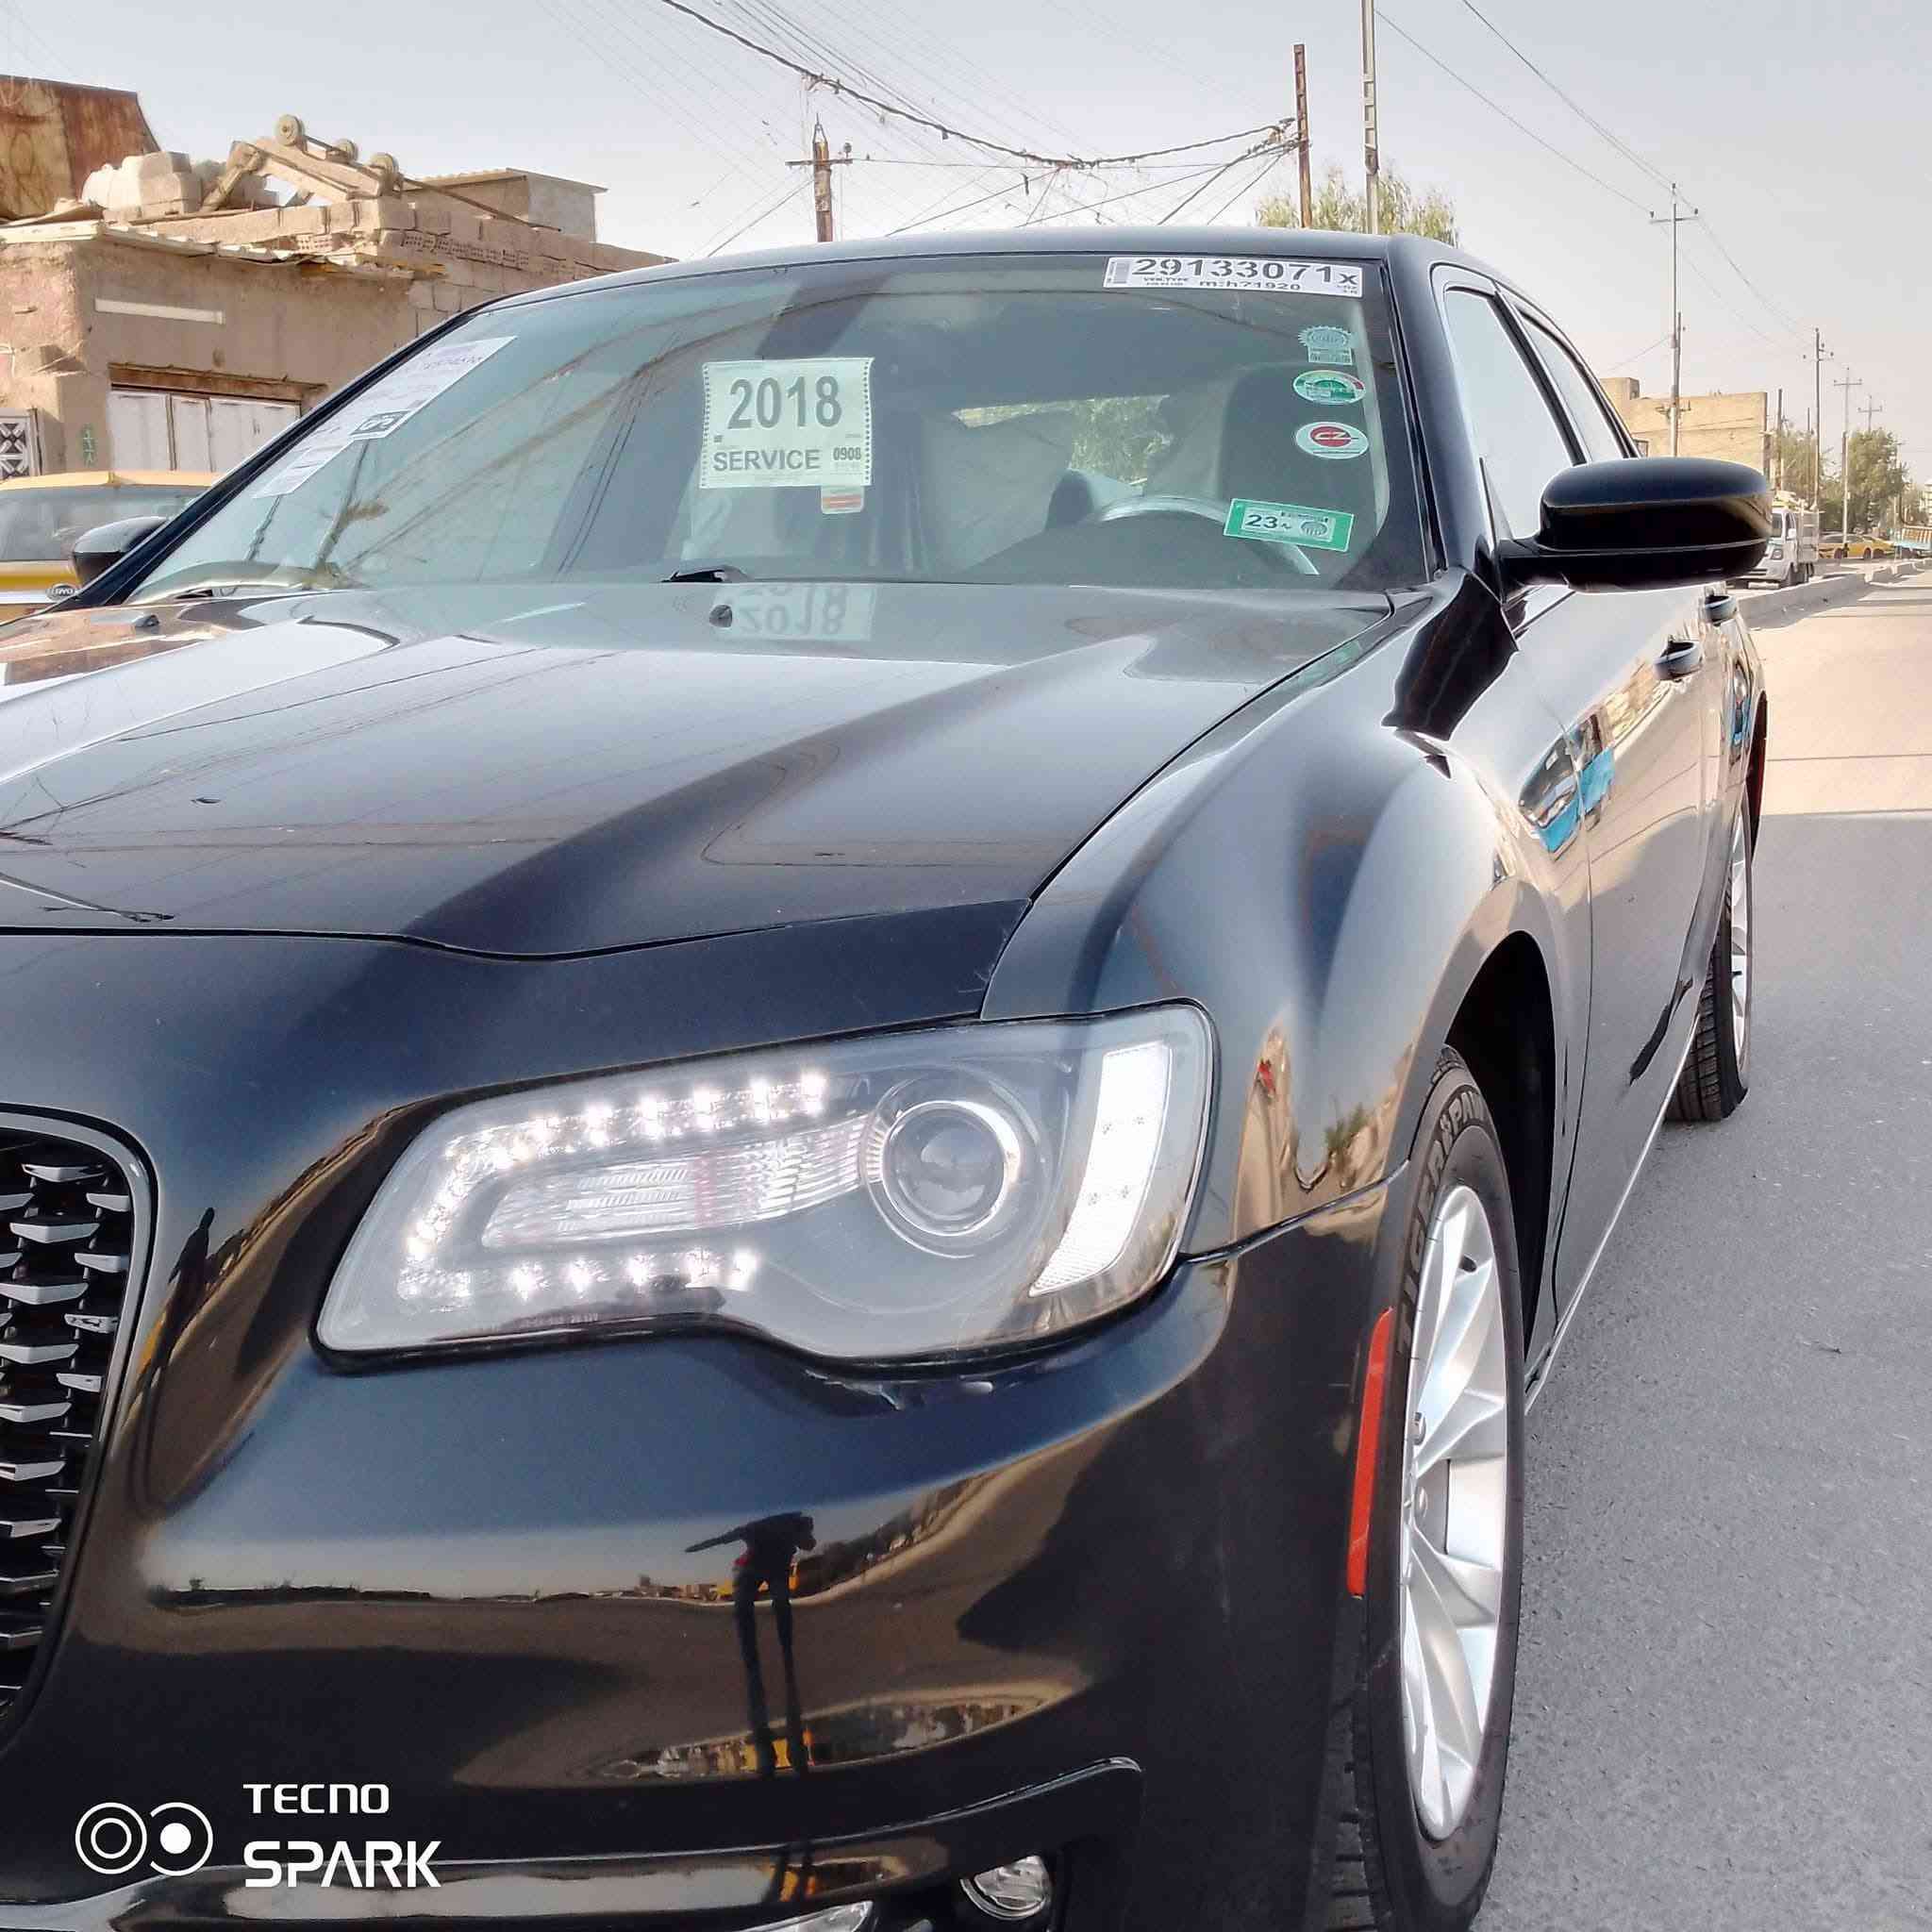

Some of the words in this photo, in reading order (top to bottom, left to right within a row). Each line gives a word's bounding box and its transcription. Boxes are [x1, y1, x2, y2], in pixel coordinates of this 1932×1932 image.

[727, 375, 842, 430] 2018
[712, 449, 821, 472] SERVICE
[832, 446, 862, 461] 0908
